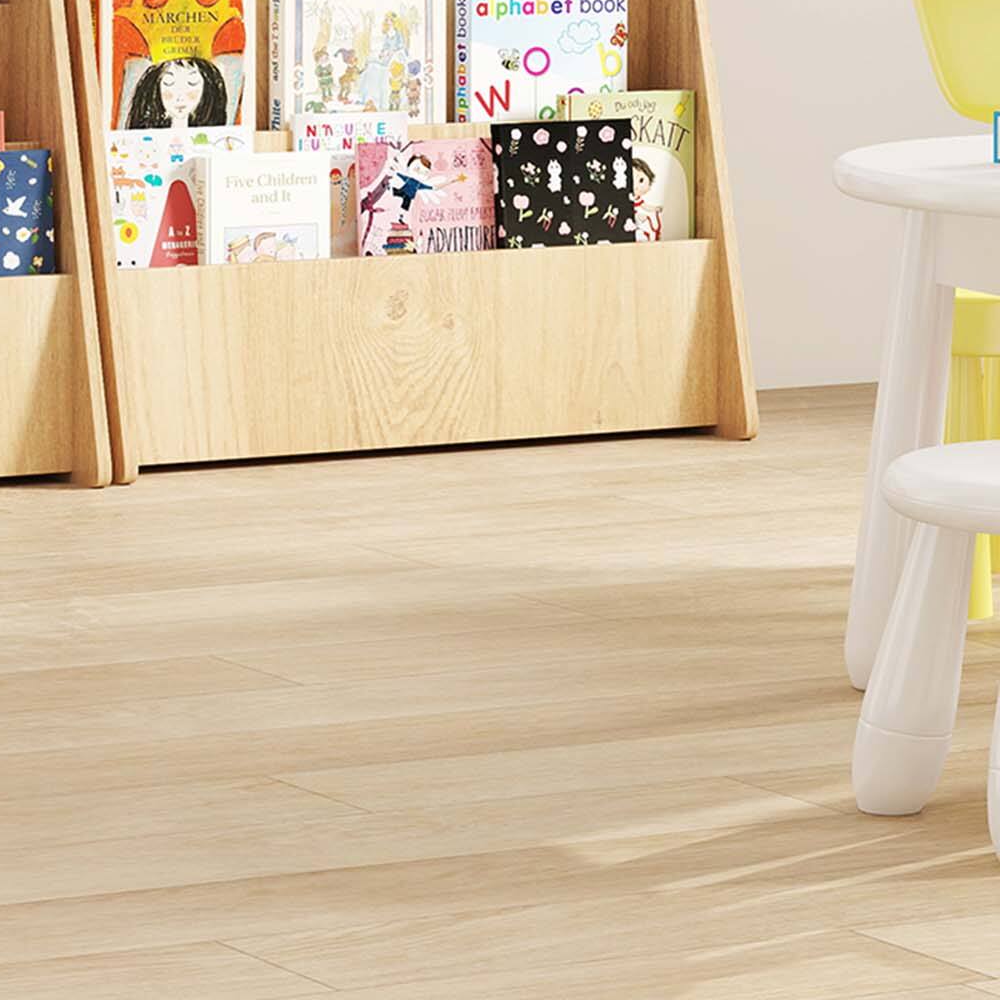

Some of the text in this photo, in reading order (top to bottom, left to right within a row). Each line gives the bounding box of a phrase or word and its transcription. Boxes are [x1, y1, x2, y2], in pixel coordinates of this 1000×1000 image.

[456, 44, 469, 122] alphabet
[225, 172, 318, 189] Five Children
[250, 189, 292, 204] and It
